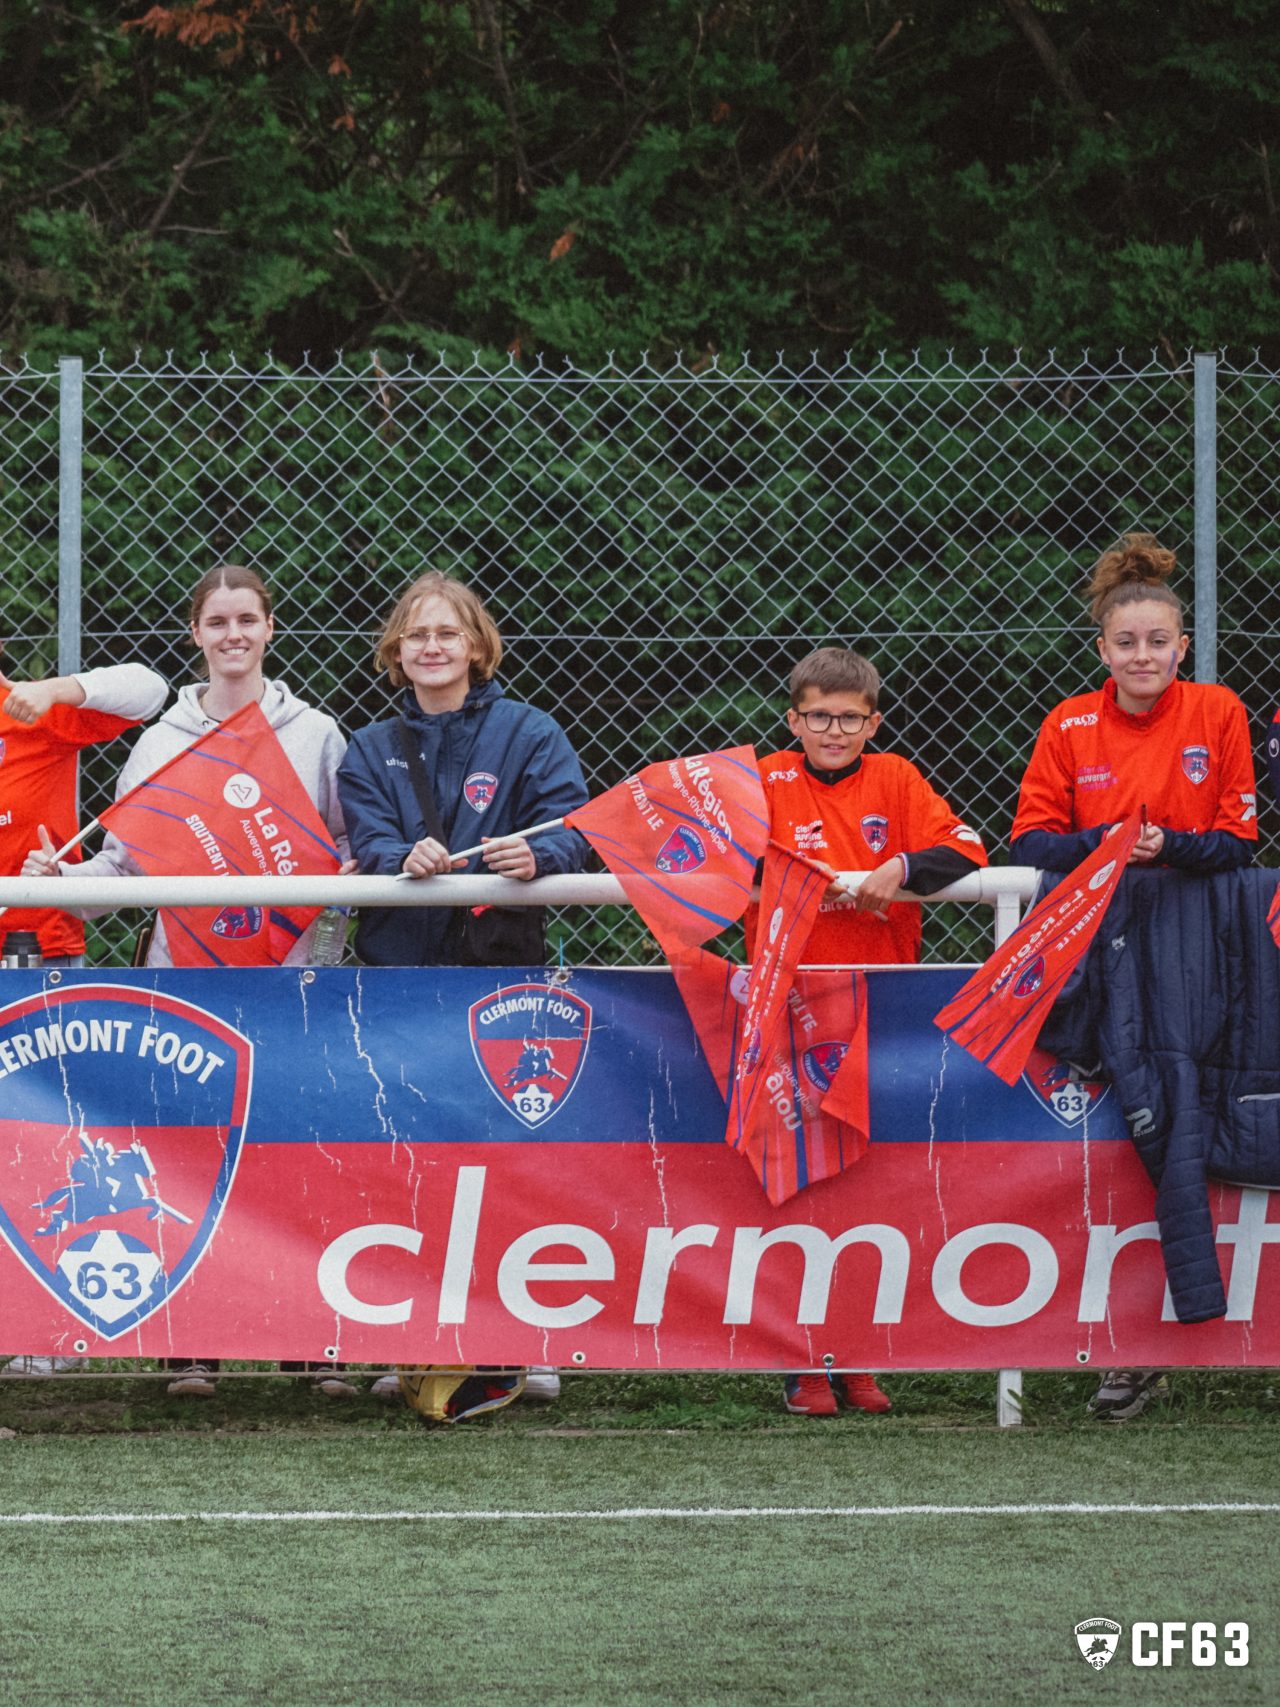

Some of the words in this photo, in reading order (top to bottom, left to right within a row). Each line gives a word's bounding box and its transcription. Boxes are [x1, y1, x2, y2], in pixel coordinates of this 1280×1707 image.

[254, 806, 279, 840] La
[646, 813, 665, 831] LE
[185, 814, 228, 871] SOUTIENT
[479, 997, 545, 1026] CLERMONT
[546, 999, 581, 1024] FOOT
[137, 1025, 225, 1085] FOOT
[519, 1097, 546, 1113] 63
[1057, 1095, 1084, 1112] 63
[76, 1261, 142, 1300] 63
